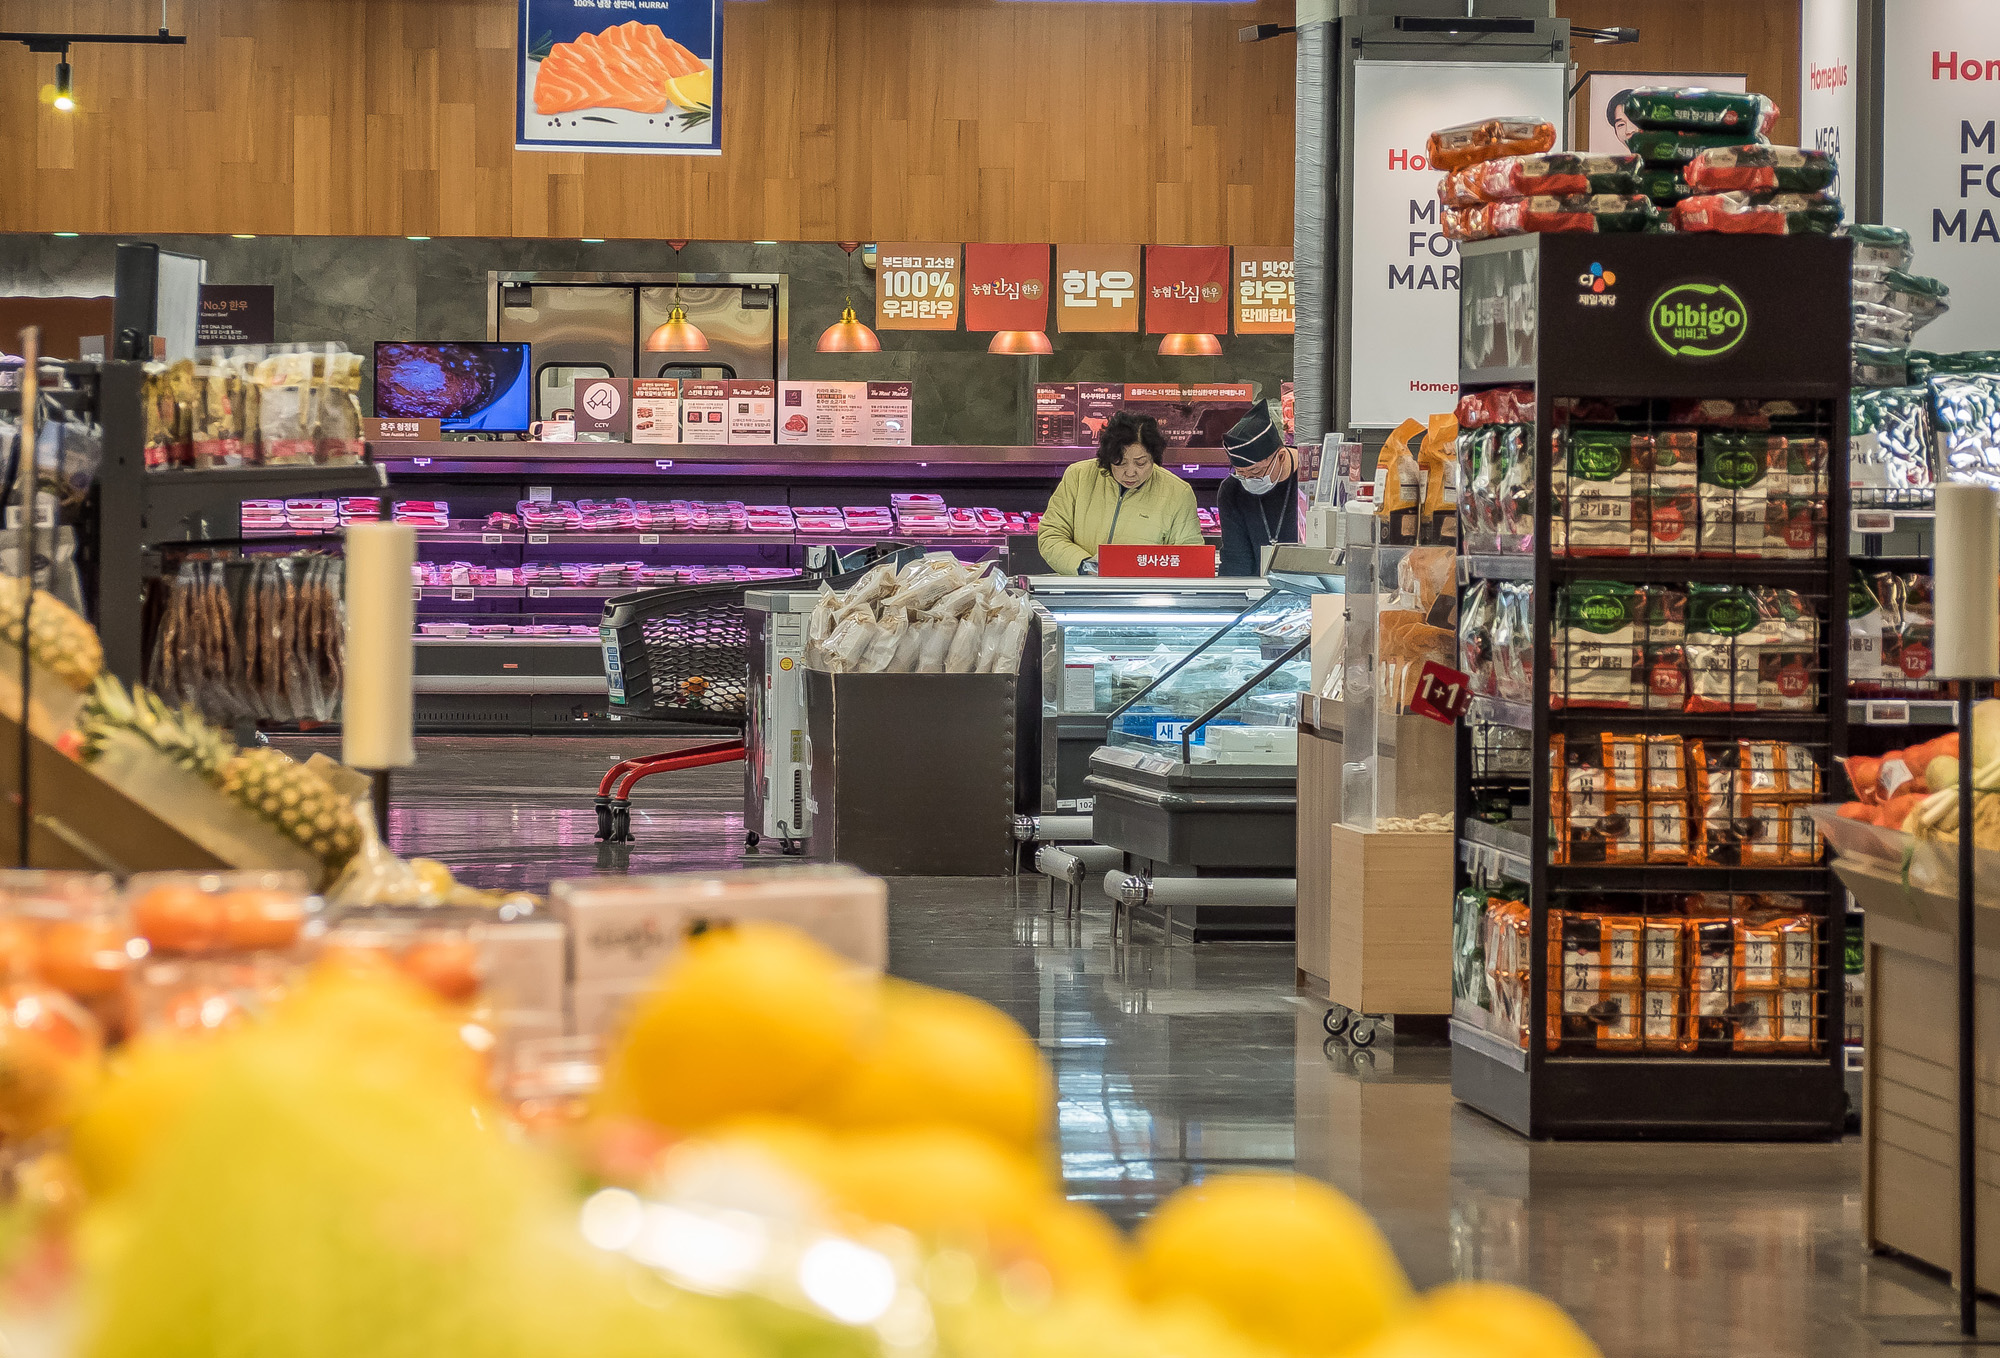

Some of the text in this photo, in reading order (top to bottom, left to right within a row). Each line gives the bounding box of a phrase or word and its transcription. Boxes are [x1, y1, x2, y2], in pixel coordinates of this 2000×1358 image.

[638, 1, 669, 9] HURRA!
[1810, 57, 1848, 95] Homeplus
[1388, 149, 1434, 170] Ho
[1409, 232, 1460, 257] FO
[882, 256, 955, 268] 부드럽고 고소한
[1241, 261, 1256, 278] 더
[882, 270, 955, 298] 100%
[1579, 274, 1595, 286] CJ
[971, 277, 1040, 300] 농협 안심 한우
[1062, 269, 1135, 308] 한우
[1151, 280, 1219, 303] 농협 안심 한우
[203, 300, 248, 311] No.9 한우
[1579, 294, 1617, 306] 제일제당
[882, 300, 953, 319] 우리한우
[1660, 303, 1741, 335] bibigo
[1674, 327, 1708, 339] 비비고
[1410, 380, 1459, 394] Homep
[380, 422, 396, 431] 호주
[1580, 502, 1622, 516] 참기름김
[1137, 554, 1180, 567] 행사상품
[1422, 673, 1460, 709] 1+1
[1079, 801, 1093, 809] 102
